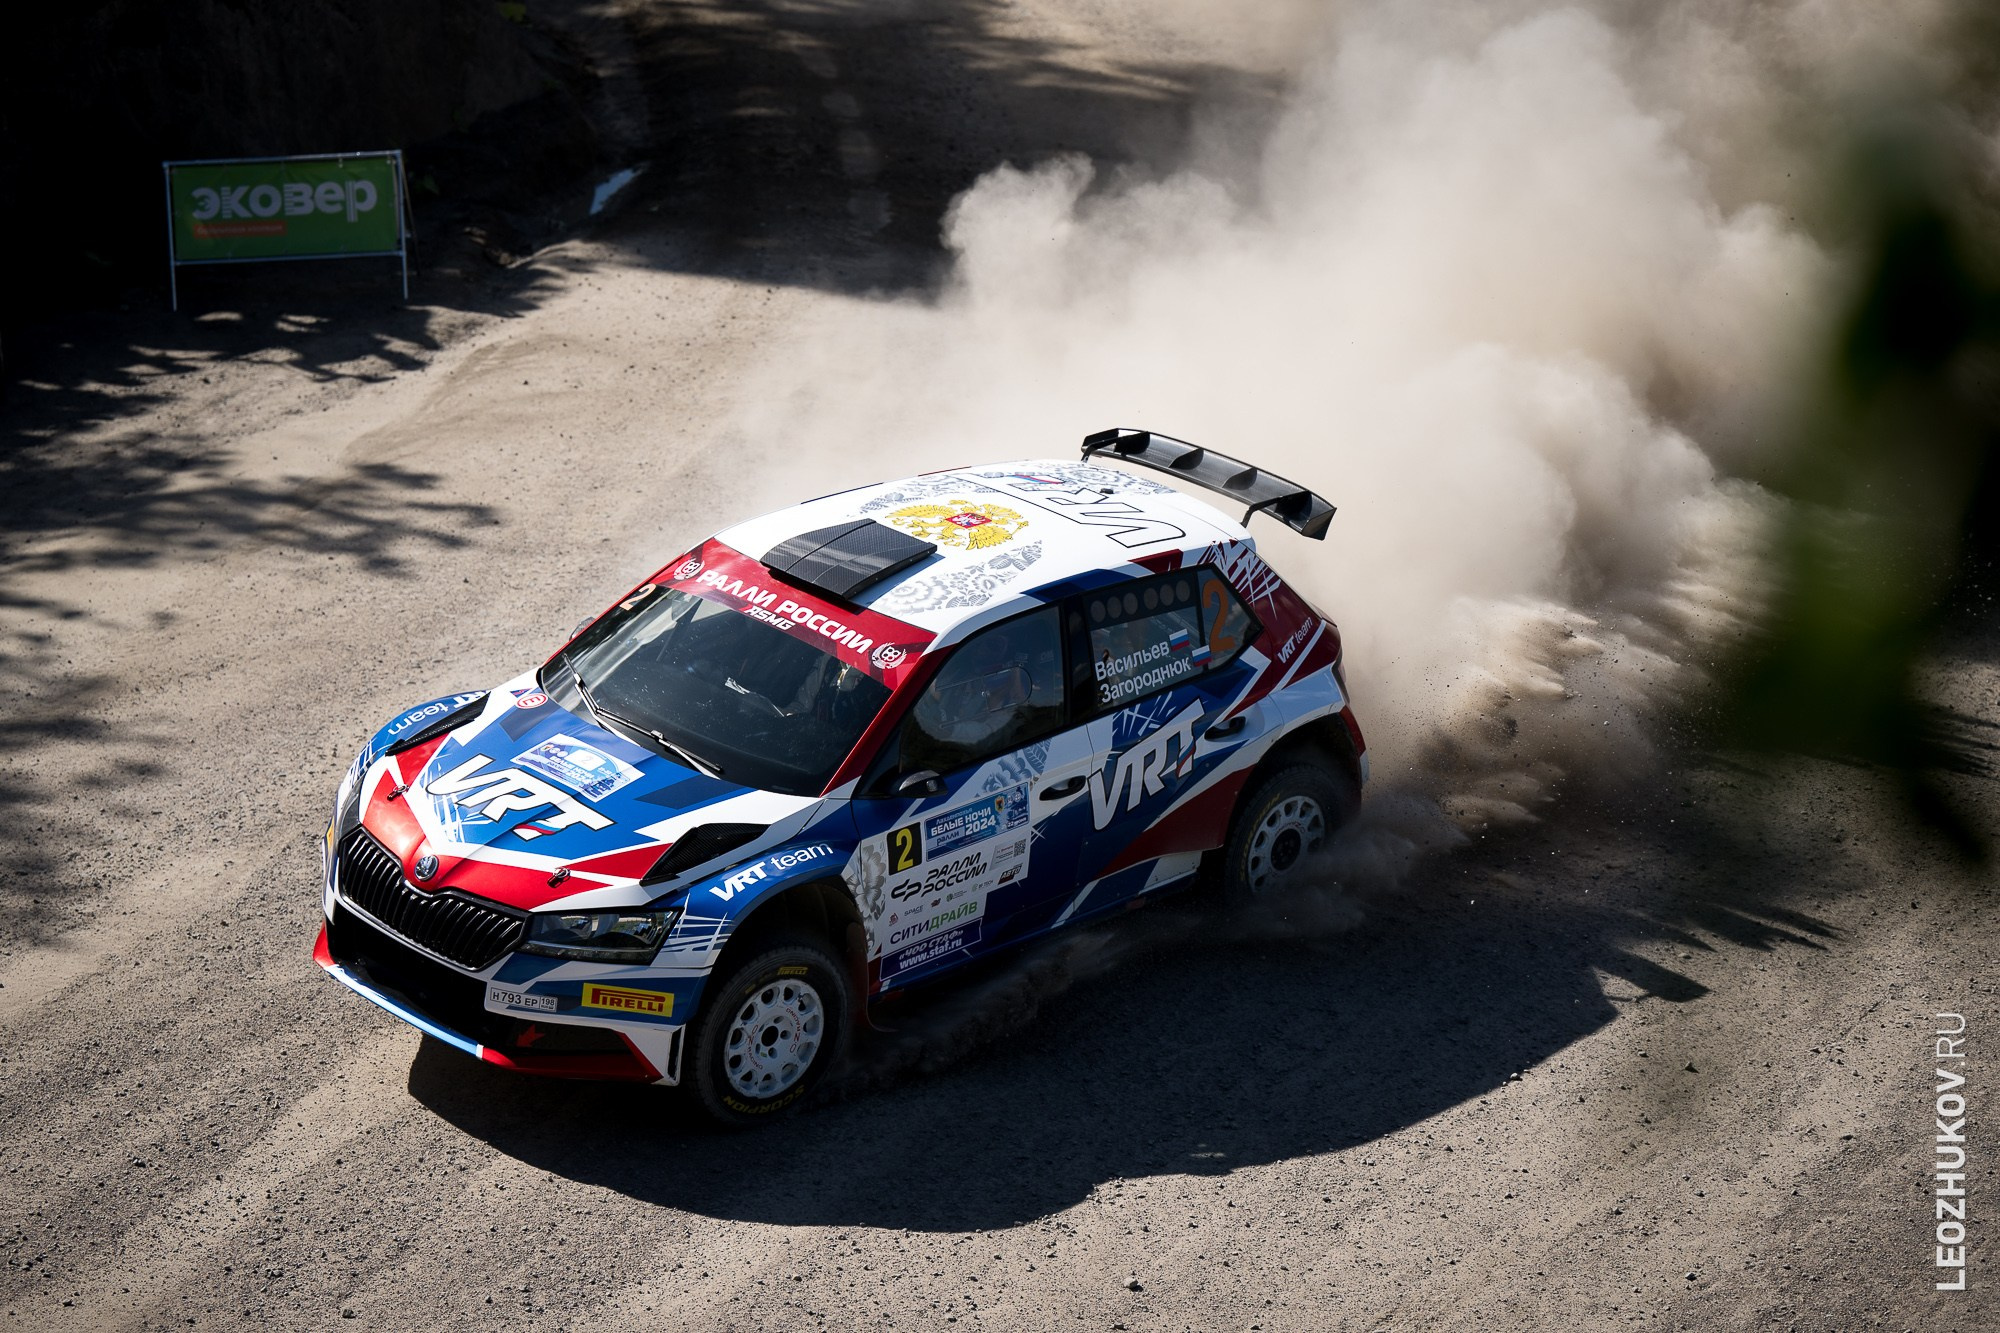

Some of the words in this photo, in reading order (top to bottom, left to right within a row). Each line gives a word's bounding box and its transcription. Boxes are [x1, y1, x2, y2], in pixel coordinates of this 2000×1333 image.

[695, 569, 777, 607] РАЛЛИ
[777, 600, 873, 654] РОССИИ
[744, 605, 797, 631] RSMG
[1202, 579, 1236, 653] 2
[1276, 635, 1298, 665] VRT
[1294, 616, 1314, 645] team
[1095, 639, 1170, 682] Васильев
[1099, 655, 1192, 704] Загороднюк
[453, 691, 487, 709] RT
[387, 702, 449, 736] team
[1088, 696, 1206, 832] VRT
[425, 753, 617, 842] VRT
[931, 817, 964, 837] БЕЛЫЕ
[965, 806, 991, 824] НОЧИ
[936, 830, 960, 846] ралли
[965, 815, 996, 836] 2024
[895, 827, 914, 872] 2
[926, 851, 982, 883] РАЛЛИ
[709, 861, 769, 902] VRT
[769, 843, 834, 871] team
[920, 862, 988, 898] РОССИИ
[890, 901, 978, 945] СИТИДРАЙВ
[777, 966, 808, 976] PIRELLI
[899, 938, 963, 970] www.staf.ru
[501, 991, 522, 1005] 793
[591, 987, 666, 1013] PIRELLI
[722, 1083, 805, 1114] SCORPION
